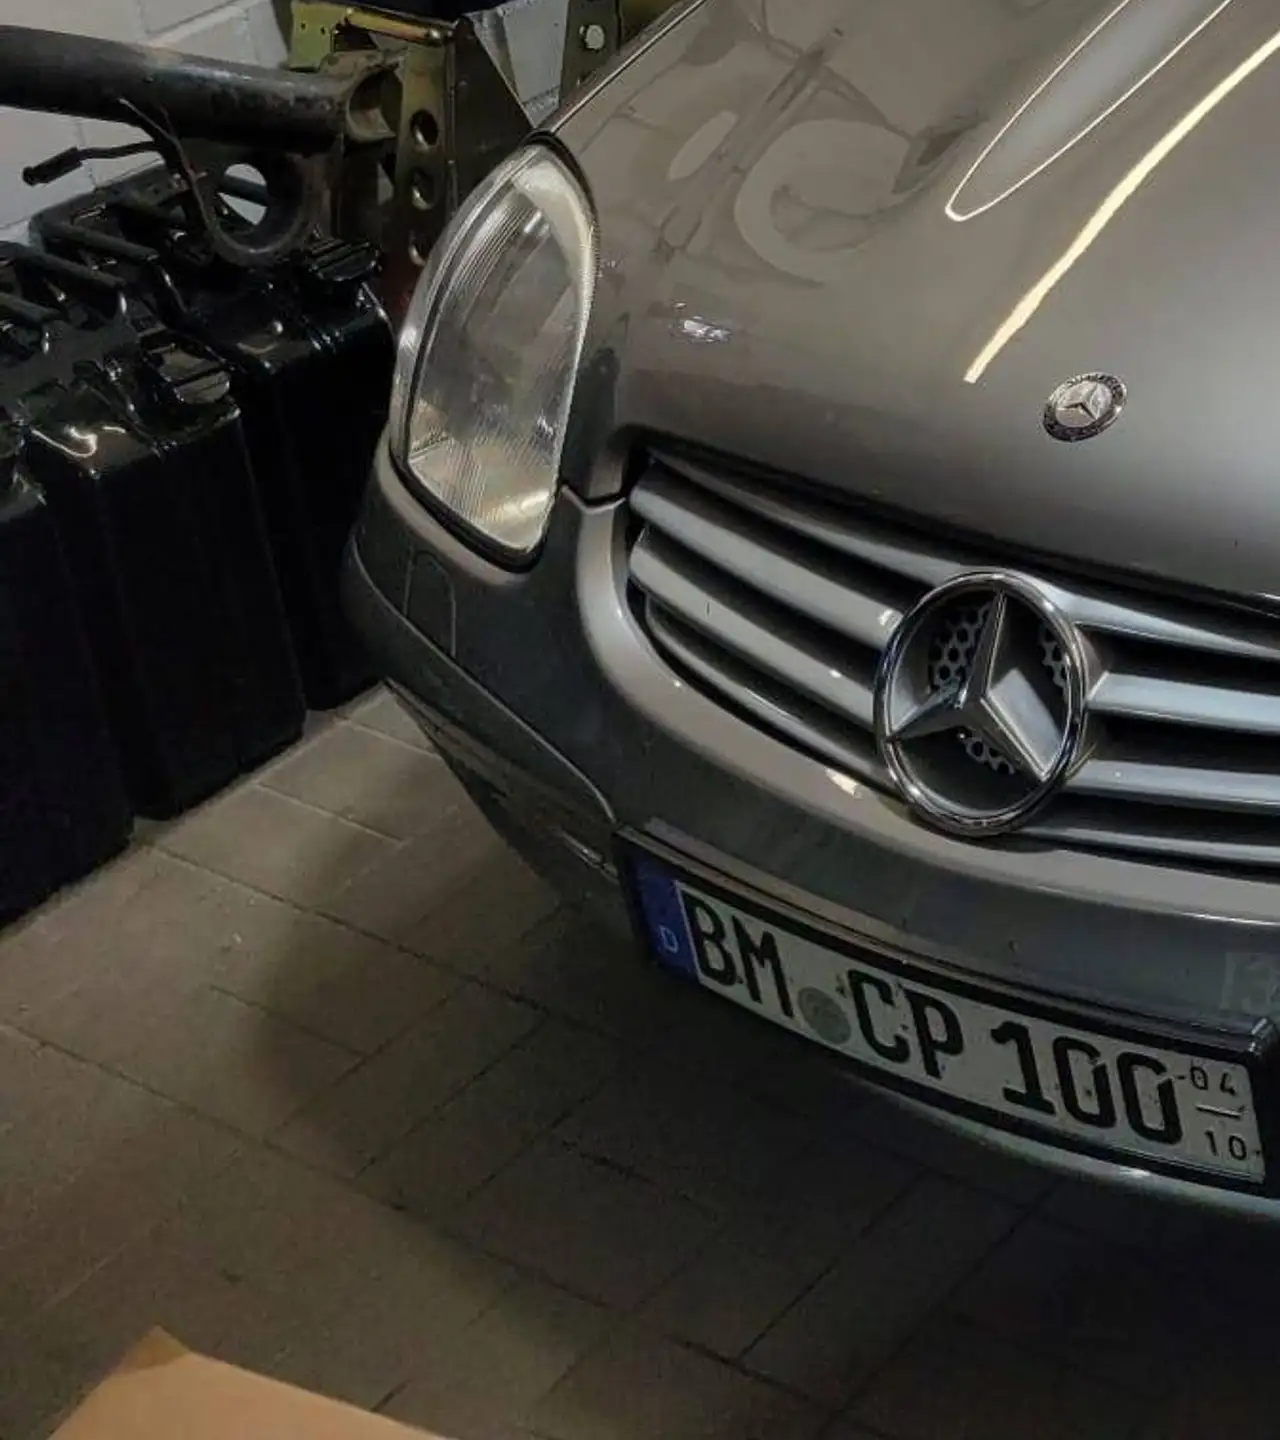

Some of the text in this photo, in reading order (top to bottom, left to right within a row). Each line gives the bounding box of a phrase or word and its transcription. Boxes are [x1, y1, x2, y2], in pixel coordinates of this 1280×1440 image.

[660, 924, 680, 954] D
[683, 890, 1184, 1145] BM CP 100
[1189, 1065, 1237, 1096] 04
[1203, 1129, 1248, 1161] 10
